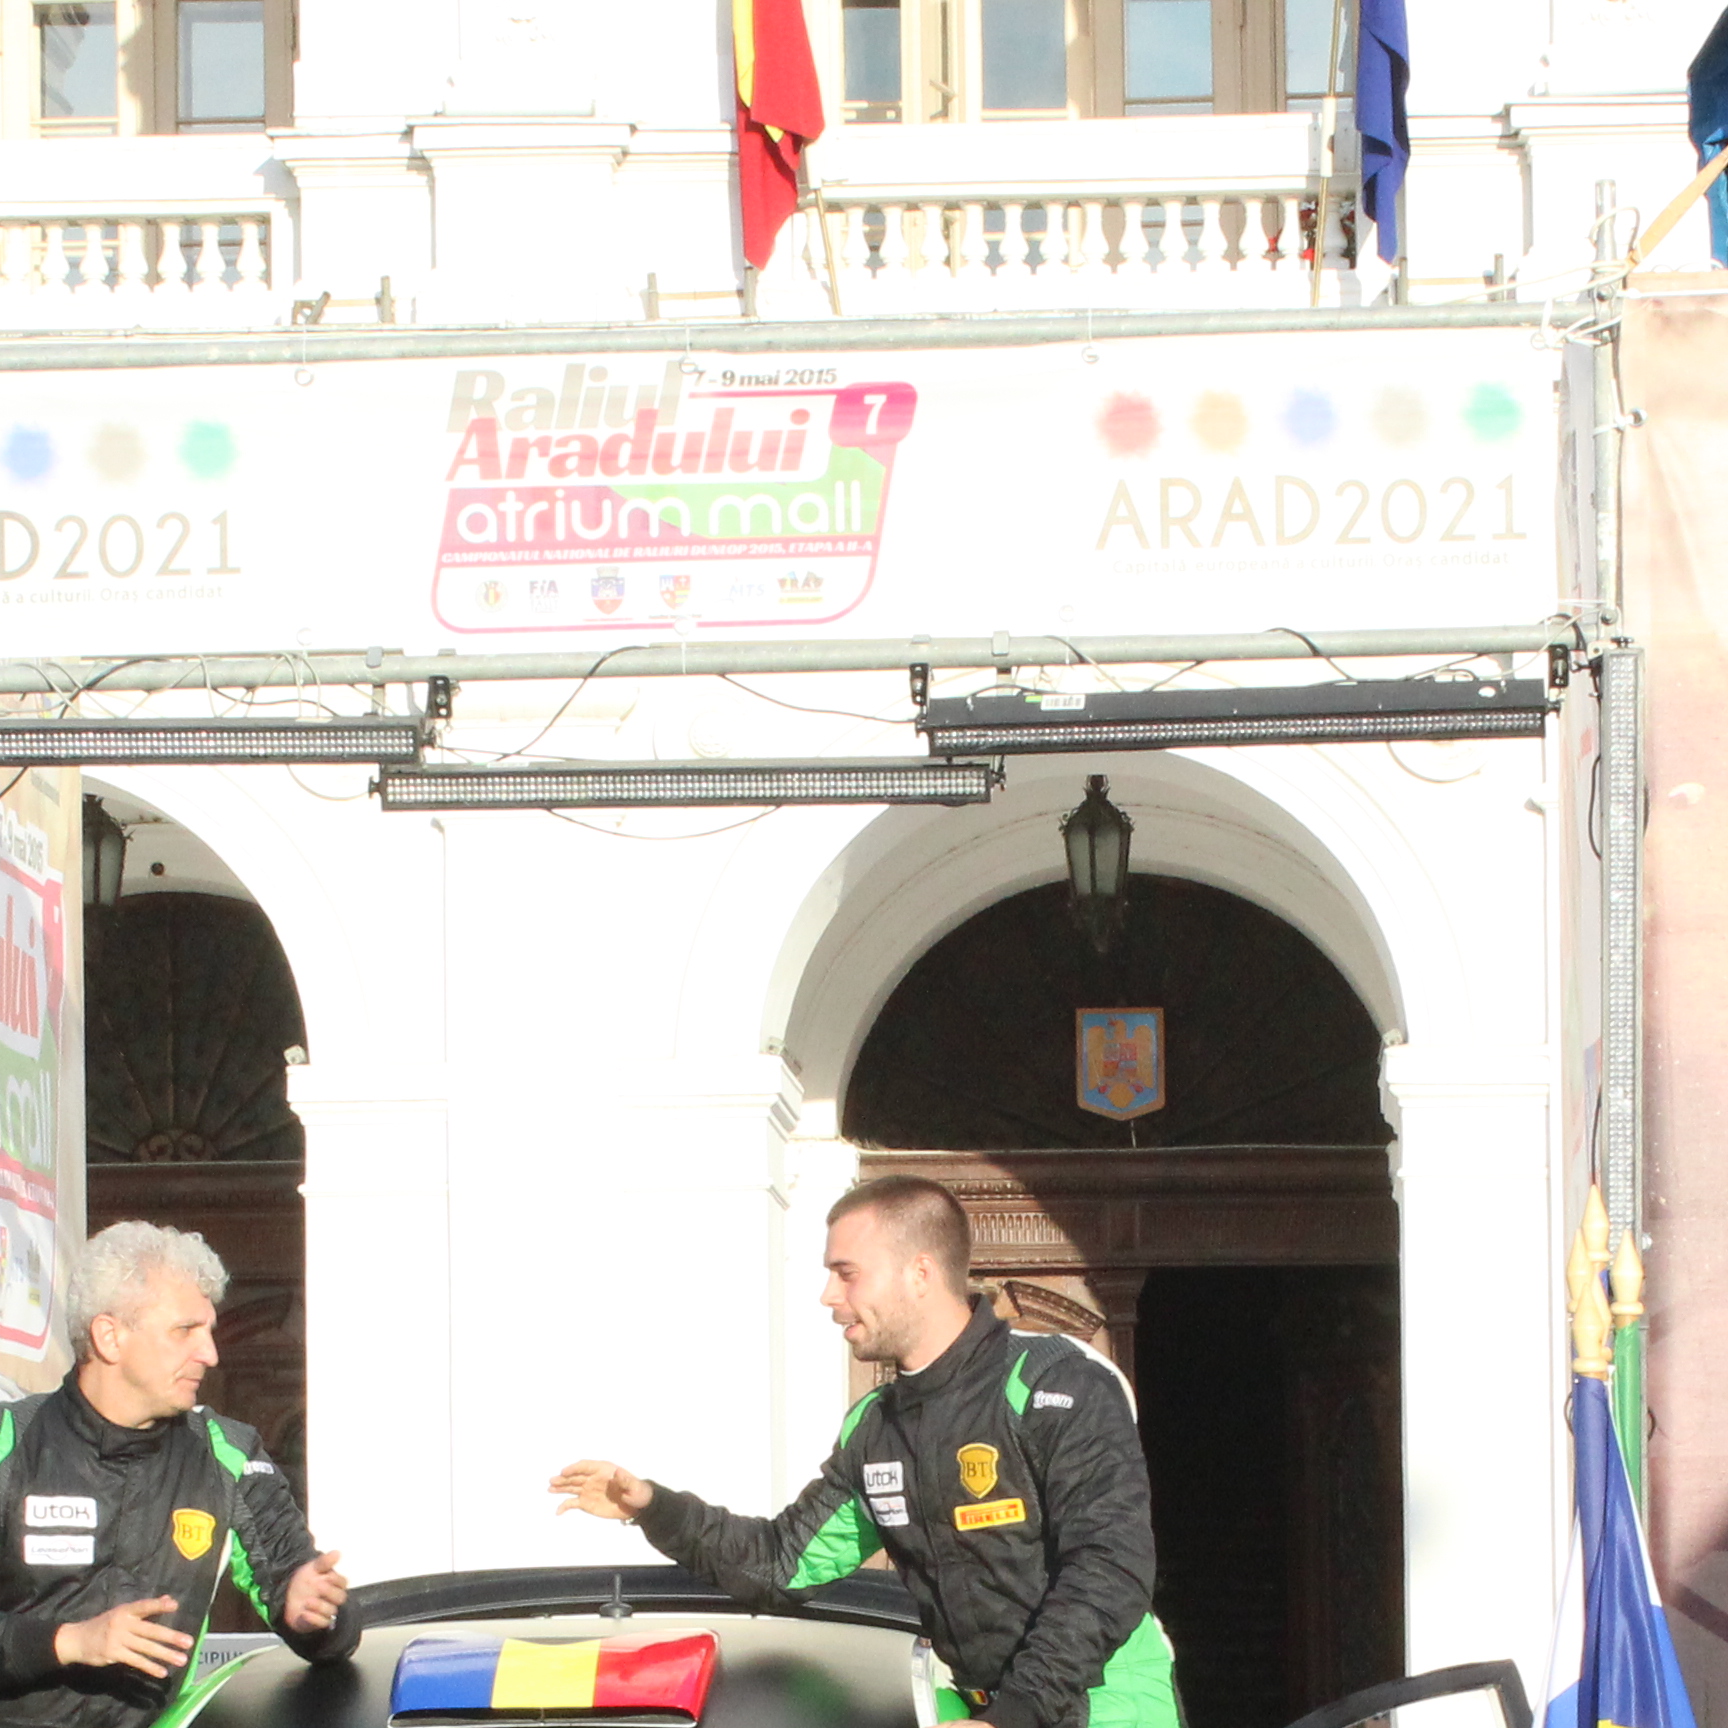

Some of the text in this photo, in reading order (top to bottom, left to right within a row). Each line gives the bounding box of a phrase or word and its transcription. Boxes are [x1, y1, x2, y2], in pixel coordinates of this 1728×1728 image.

[446, 360, 680, 433] Raliul
[444, 405, 812, 482] Aradului
[456, 480, 861, 543] atrium mall
[181, 1522, 205, 1542] BT
